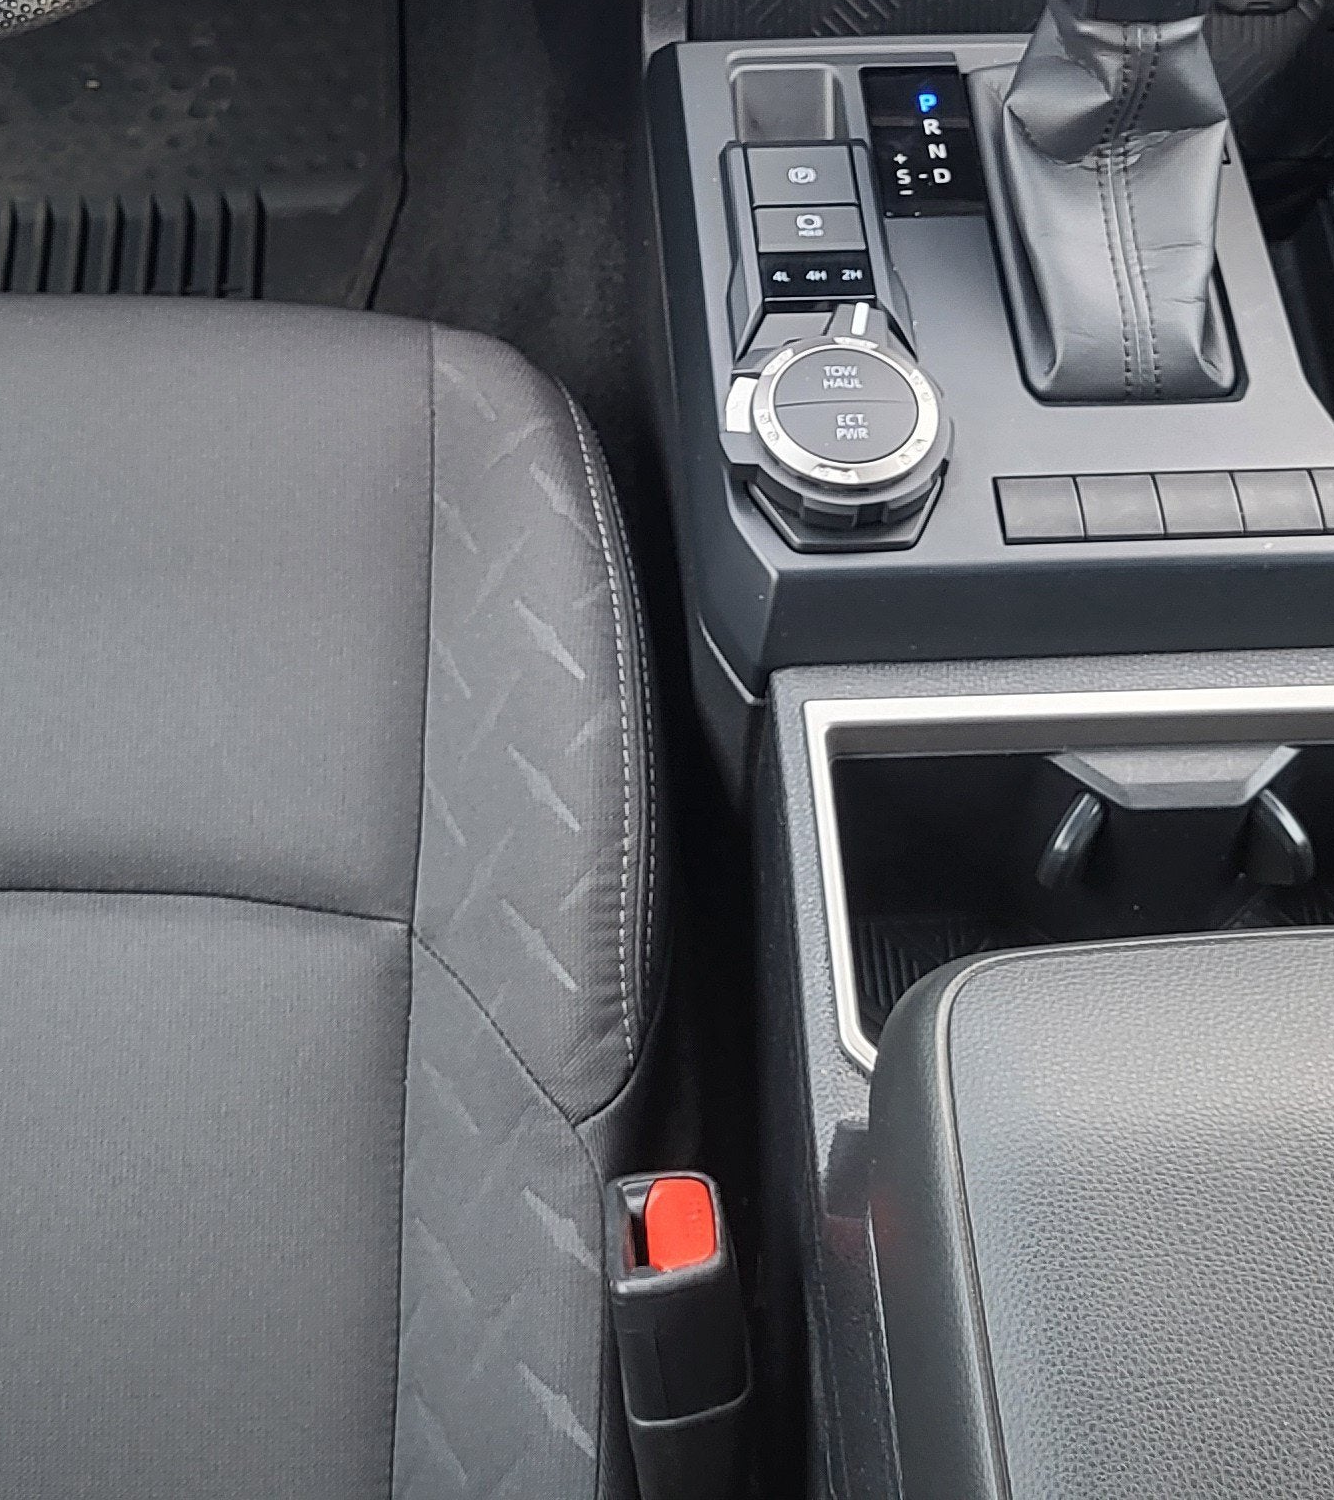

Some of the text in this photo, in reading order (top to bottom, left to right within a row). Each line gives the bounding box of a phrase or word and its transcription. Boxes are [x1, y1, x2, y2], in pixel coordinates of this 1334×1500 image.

[919, 93, 937, 113] P
[923, 118, 942, 135] R
[928, 143, 947, 159] N
[896, 168, 952, 185] S D
[772, 270, 791, 282] 4L
[805, 269, 827, 281] 4H
[841, 269, 863, 281] 2H
[823, 365, 858, 377] TOW
[822, 378, 863, 389] HAUL
[836, 427, 869, 440] PWR
